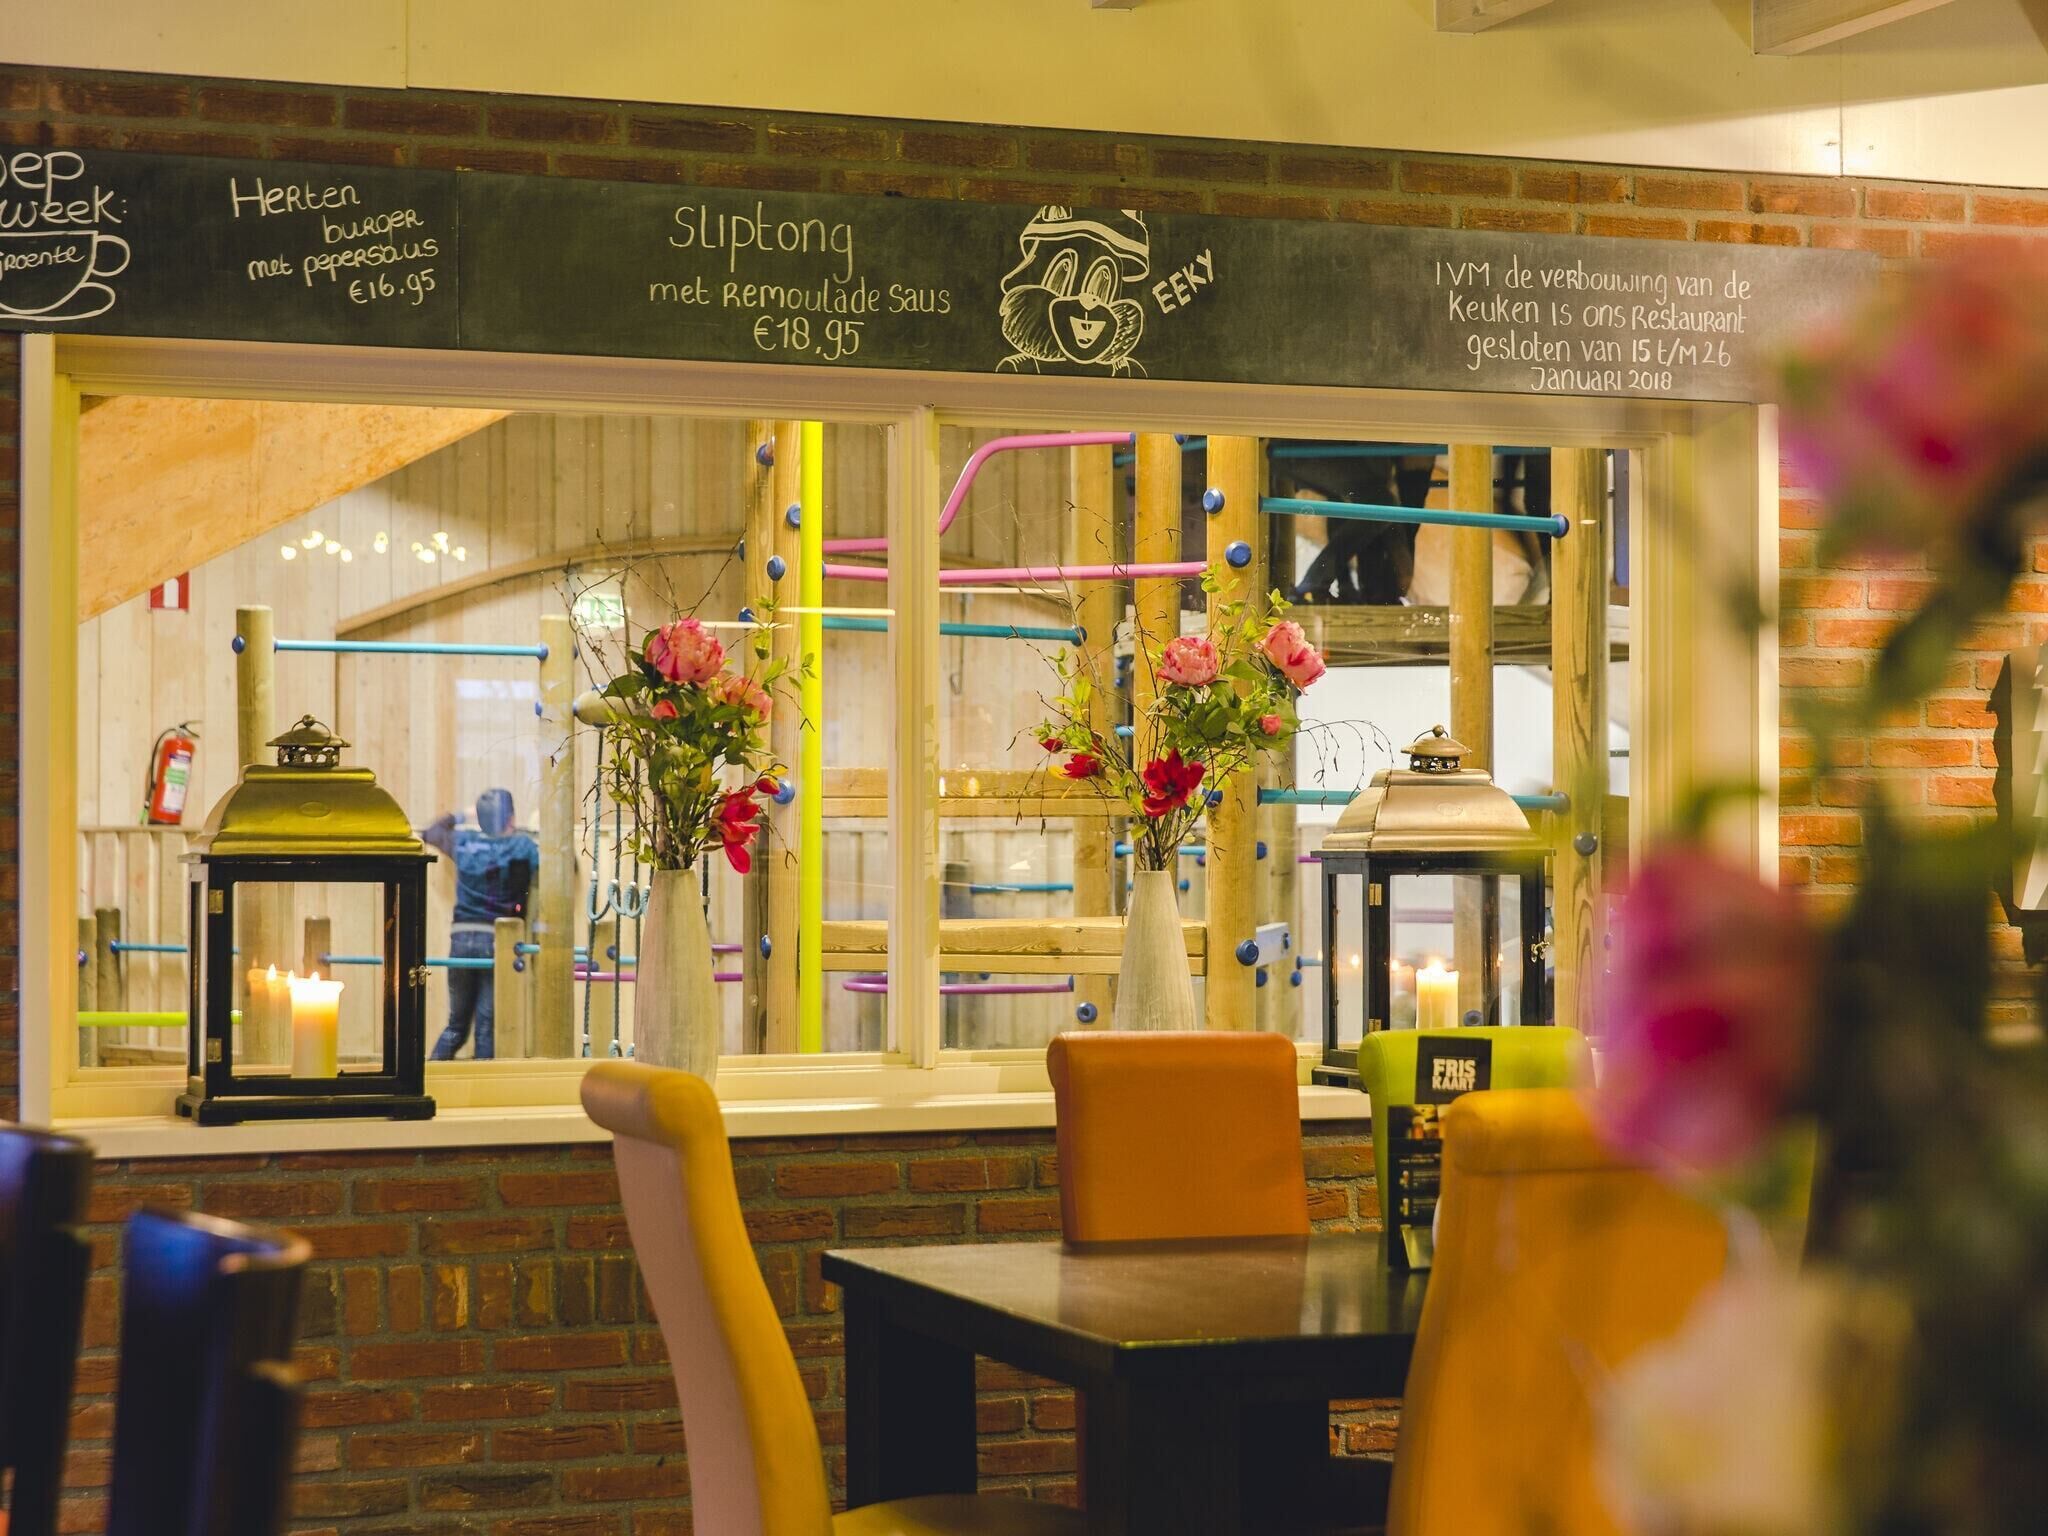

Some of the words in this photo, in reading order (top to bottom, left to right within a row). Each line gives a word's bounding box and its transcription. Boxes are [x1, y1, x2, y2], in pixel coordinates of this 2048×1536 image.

[248, 253, 293, 281] met
[1151, 248, 1214, 314] EEKY
[1504, 254, 1533, 289] de
[1675, 275, 1713, 297] van
[1723, 270, 1752, 300] de
[349, 268, 436, 306] €16.95
[650, 276, 710, 305] met
[722, 278, 880, 314] Remoulade
[1448, 290, 1539, 323] Keuken
[1582, 304, 1626, 328] ons
[753, 315, 865, 361] €18,95
[1467, 330, 1571, 371] gesloten
[1580, 339, 1622, 362] van
[1632, 339, 1651, 363] 15
[1702, 342, 1732, 367] 26
[1627, 369, 1673, 391] 2018
[1432, 1076, 1476, 1091] KAART
[1433, 1058, 1477, 1077] FRIS
